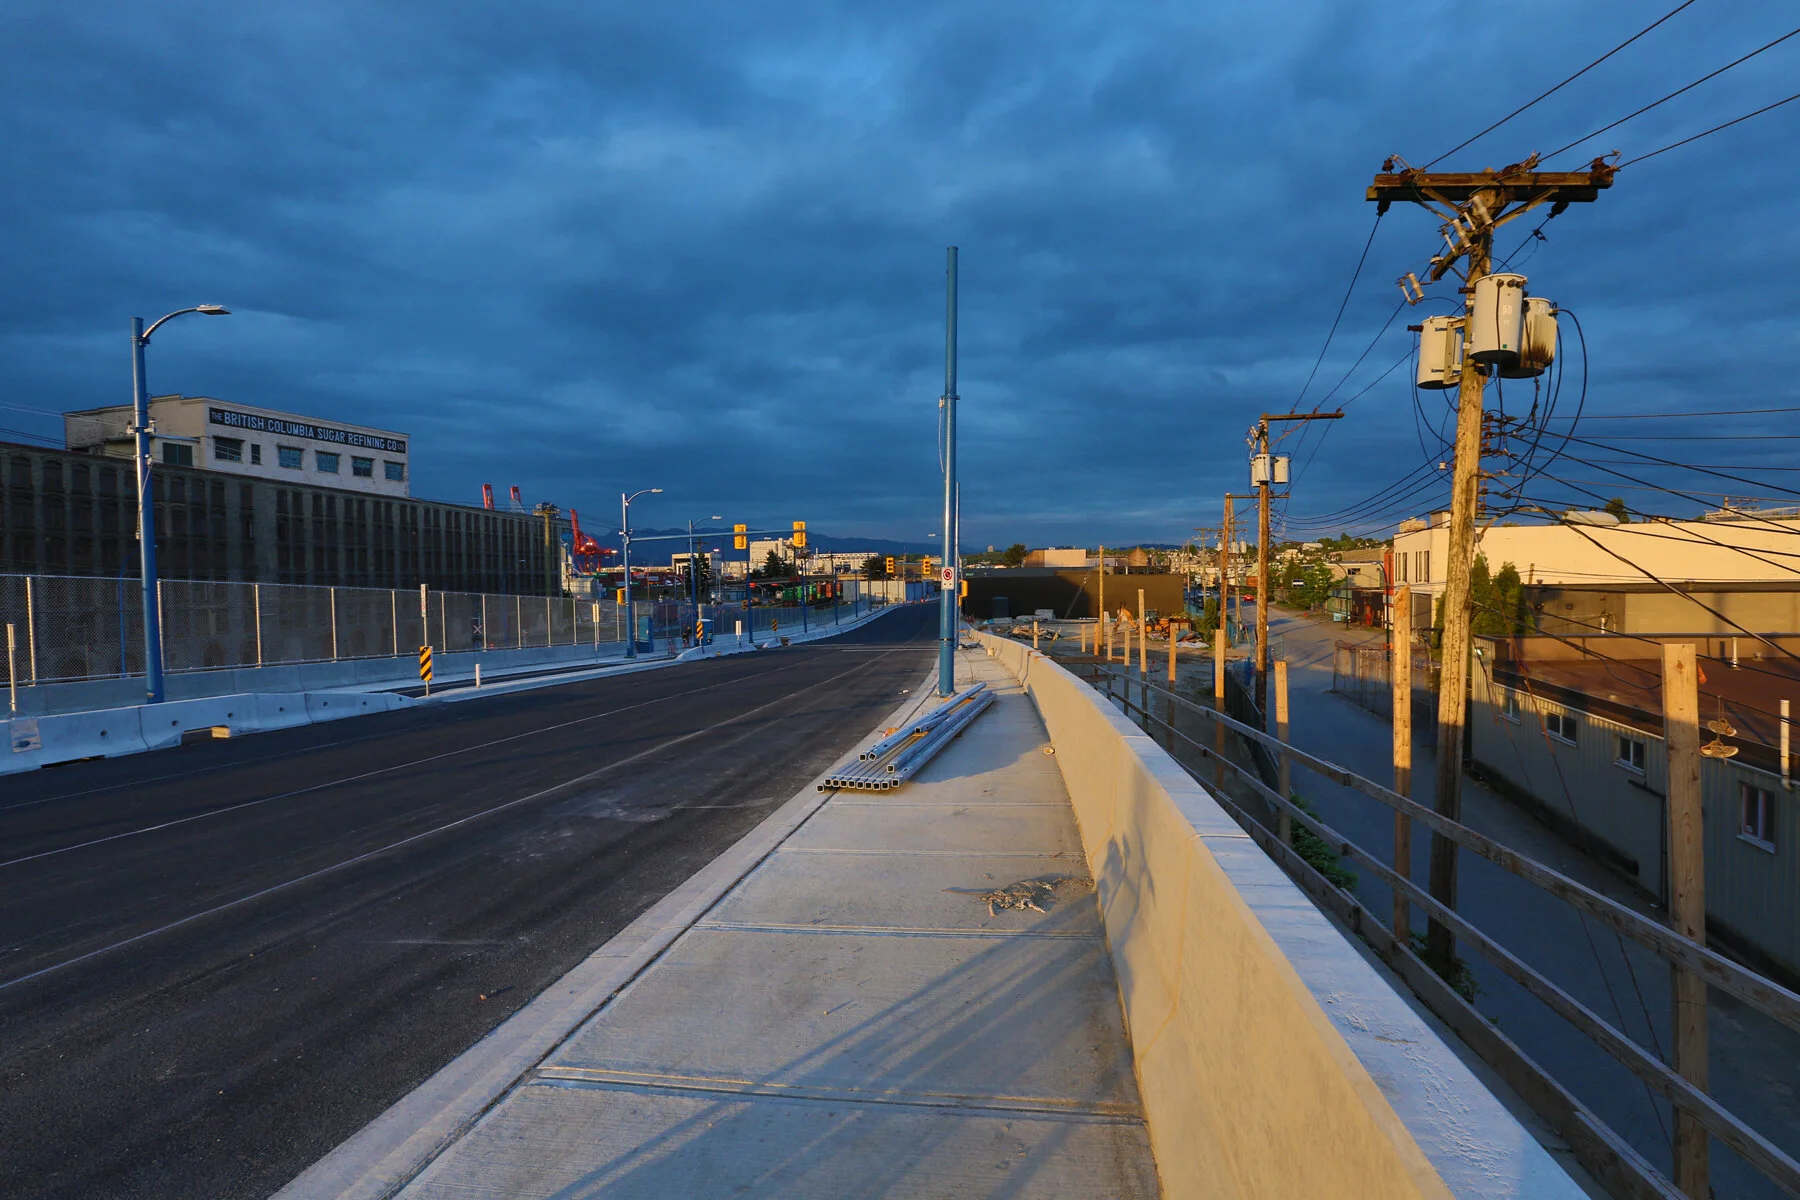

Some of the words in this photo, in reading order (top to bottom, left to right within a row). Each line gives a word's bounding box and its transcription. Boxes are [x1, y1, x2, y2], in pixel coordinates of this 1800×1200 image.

[211, 411, 223, 421] THE
[224, 411, 265, 430] BRITISH
[267, 419, 315, 437] COLUMBIA
[317, 428, 346, 443] SUGAR
[347, 433, 385, 449] REFINING
[386, 440, 397, 451] CO
